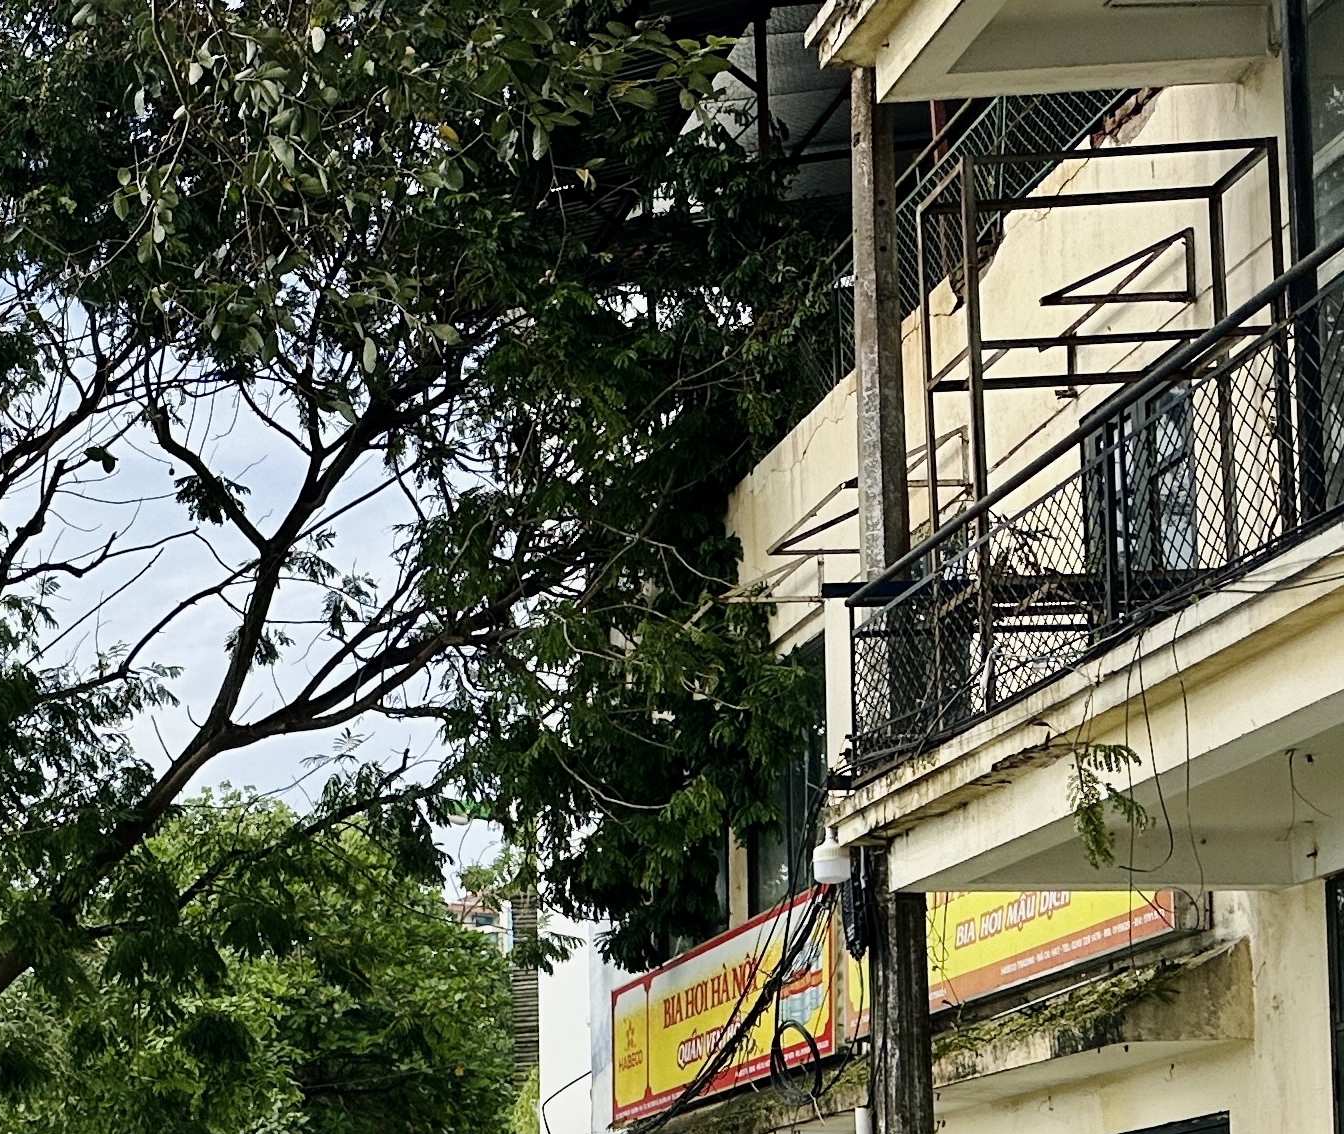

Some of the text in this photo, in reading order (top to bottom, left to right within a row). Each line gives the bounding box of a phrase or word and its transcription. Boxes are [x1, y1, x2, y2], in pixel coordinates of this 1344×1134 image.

[955, 919, 976, 949] BIA
[1005, 893, 1036, 931] MẬU
[1038, 891, 1070, 919] DỊCH
[663, 993, 684, 1029] BIA
[711, 963, 731, 1009] HÀ
[732, 953, 758, 1003] NỘI
[677, 1028, 703, 1070] QUÁN
